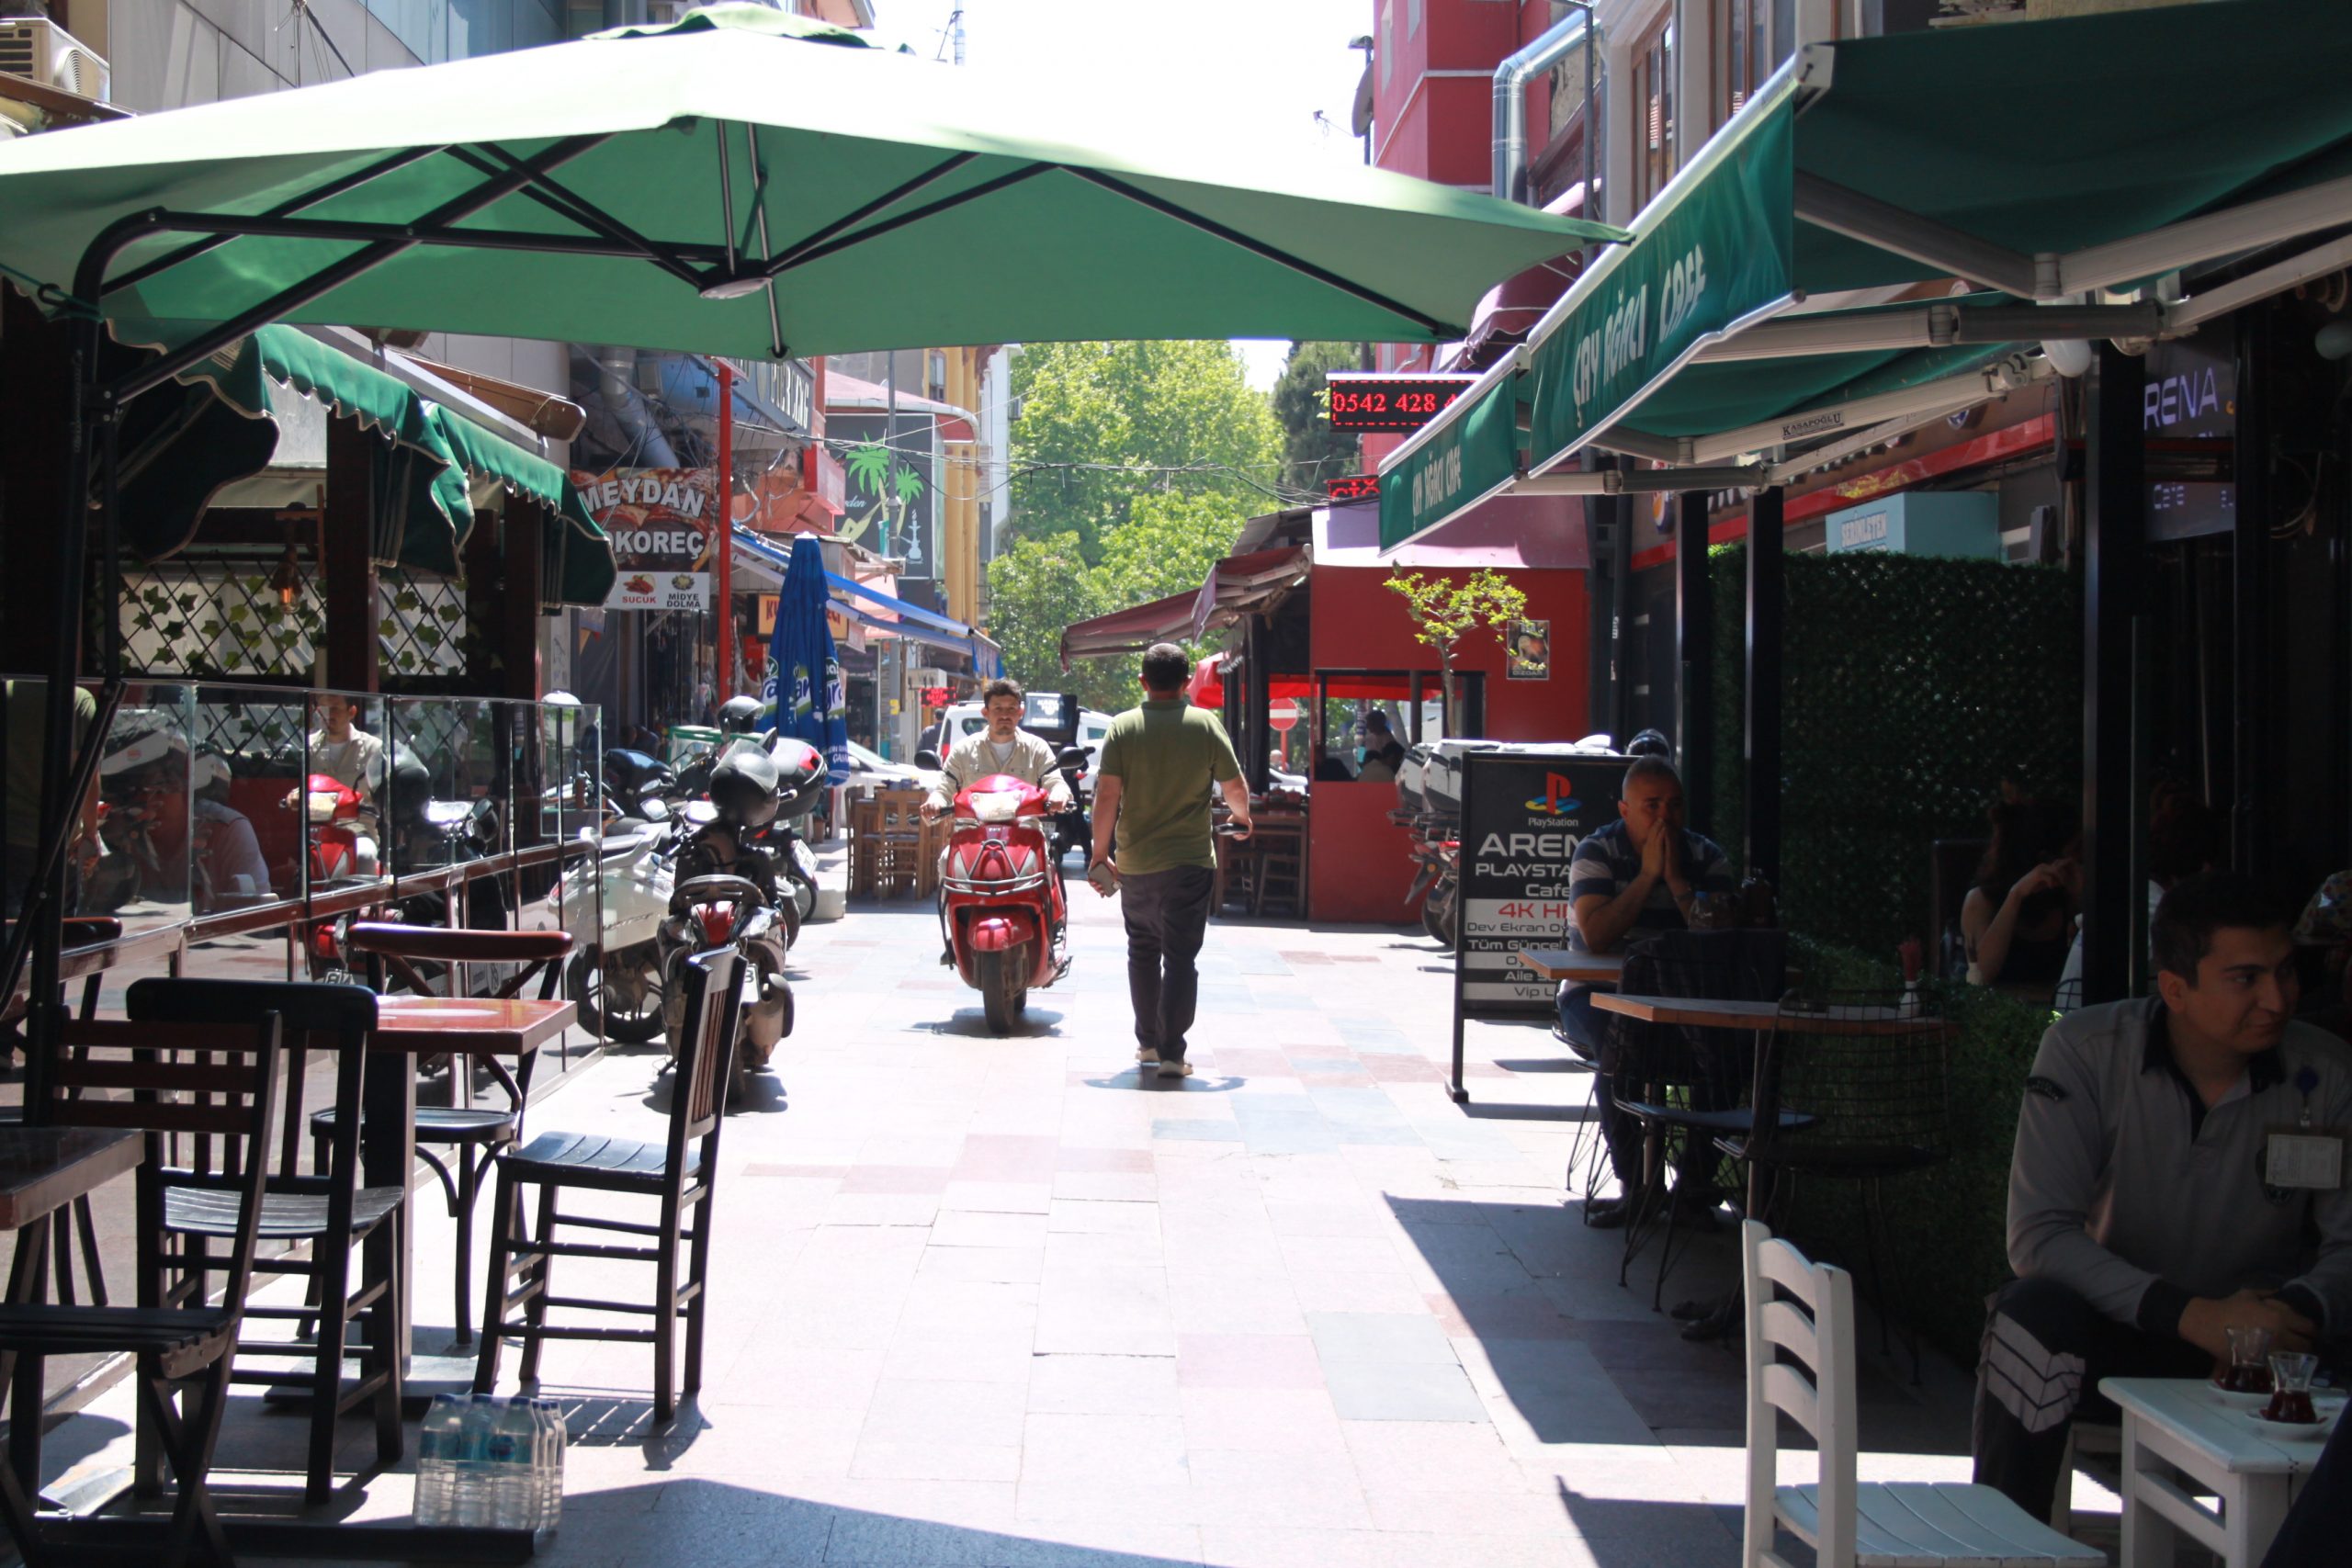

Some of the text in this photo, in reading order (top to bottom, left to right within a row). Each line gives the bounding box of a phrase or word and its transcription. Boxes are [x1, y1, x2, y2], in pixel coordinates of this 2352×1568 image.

[1333, 393, 1387, 412] 0542
[1395, 393, 1436, 412] 428
[2144, 367, 2219, 431] RENA
[578, 478, 706, 518] MEYDAN
[622, 595, 657, 604] SUCUK
[668, 592, 699, 601] MİDYE
[666, 600, 701, 608] DOLMA
[1527, 817, 1579, 829] PlayStation
[1476, 832, 1579, 858] AREN
[1475, 863, 1571, 877] PLAYSTA
[1525, 883, 1571, 897] Cafe
[1498, 902, 1534, 919] 4K
[1467, 922, 1496, 932] Dev
[1500, 922, 1545, 932] Ekran
[1468, 939, 1563, 951] Tüm Güncel
[1505, 971, 1533, 981] Aile
[1514, 987, 1540, 998] Vip
